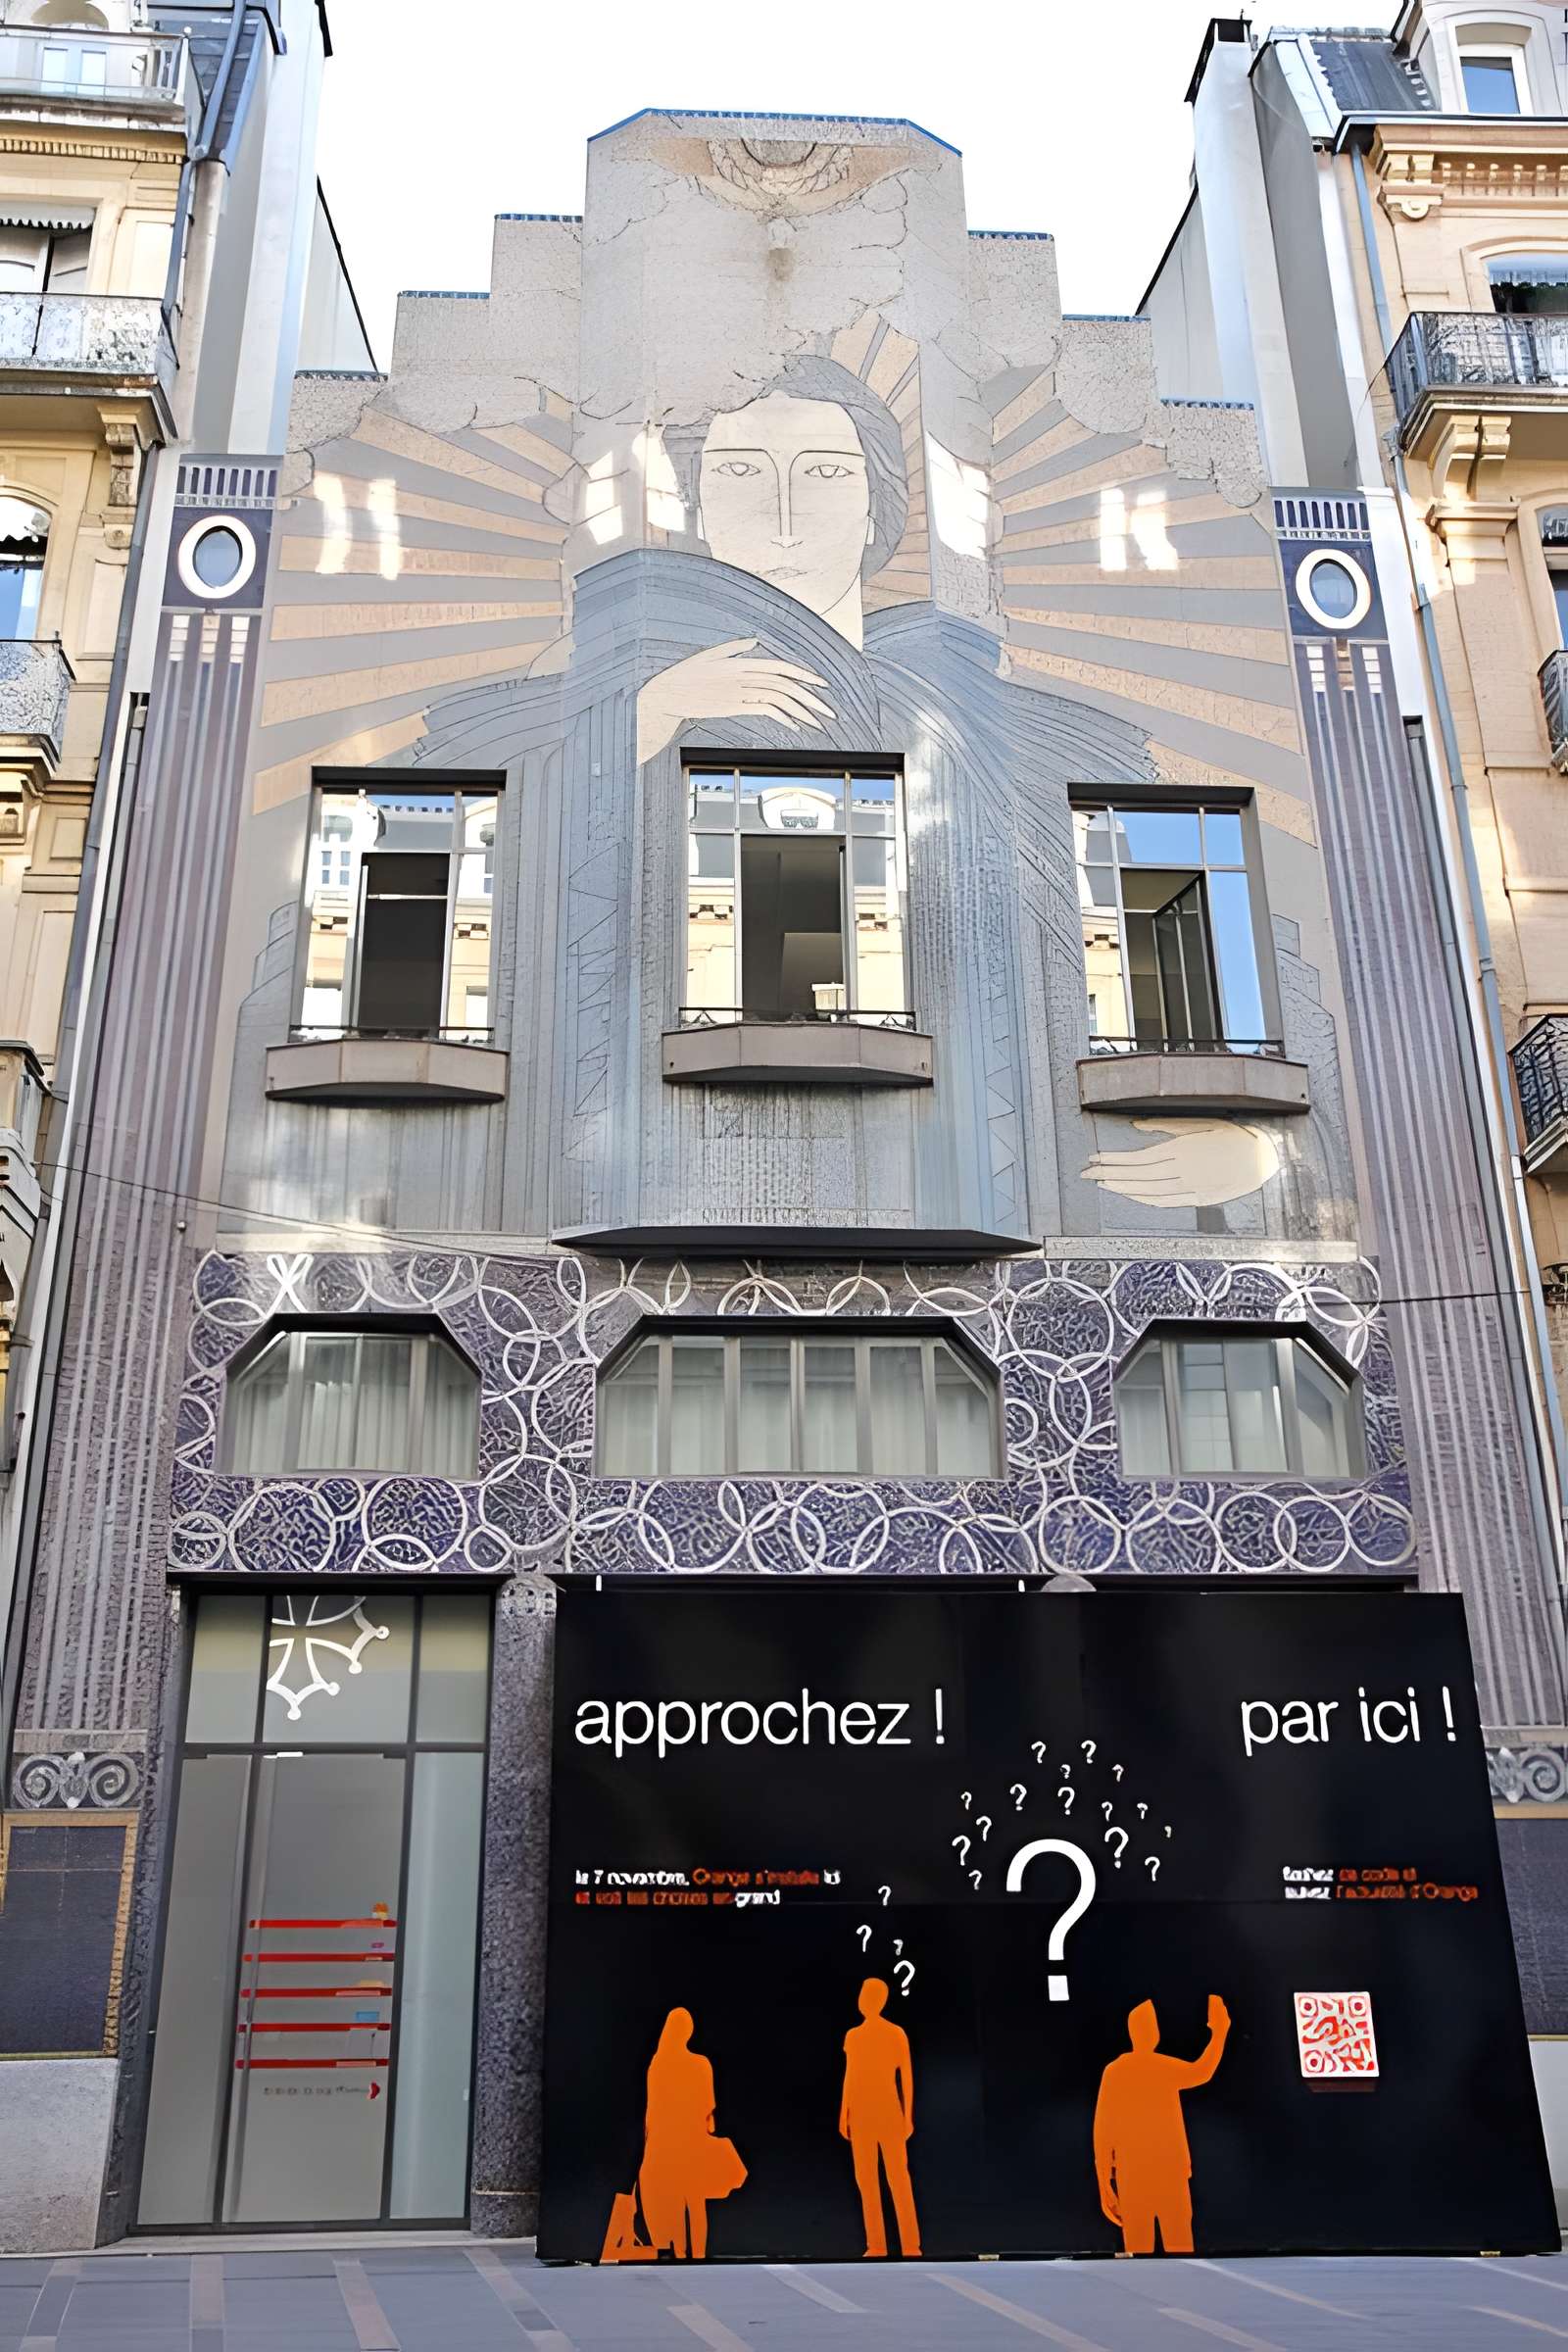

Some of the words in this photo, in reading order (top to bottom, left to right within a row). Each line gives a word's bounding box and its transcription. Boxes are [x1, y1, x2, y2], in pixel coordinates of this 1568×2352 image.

[574, 1688, 911, 1759] approchez
[935, 1688, 945, 1744] !
[1241, 1700, 1340, 1757] par
[1357, 1686, 1421, 1744] ici
[1442, 1686, 1456, 1743] !
[1080, 1740, 1097, 1764] ?
[1009, 1783, 1028, 1811] ?
[1056, 1786, 1076, 1816] ?
[1103, 1826, 1130, 1869] ?
[1005, 1838, 1097, 2002] ?
[893, 1959, 916, 1997] ?
